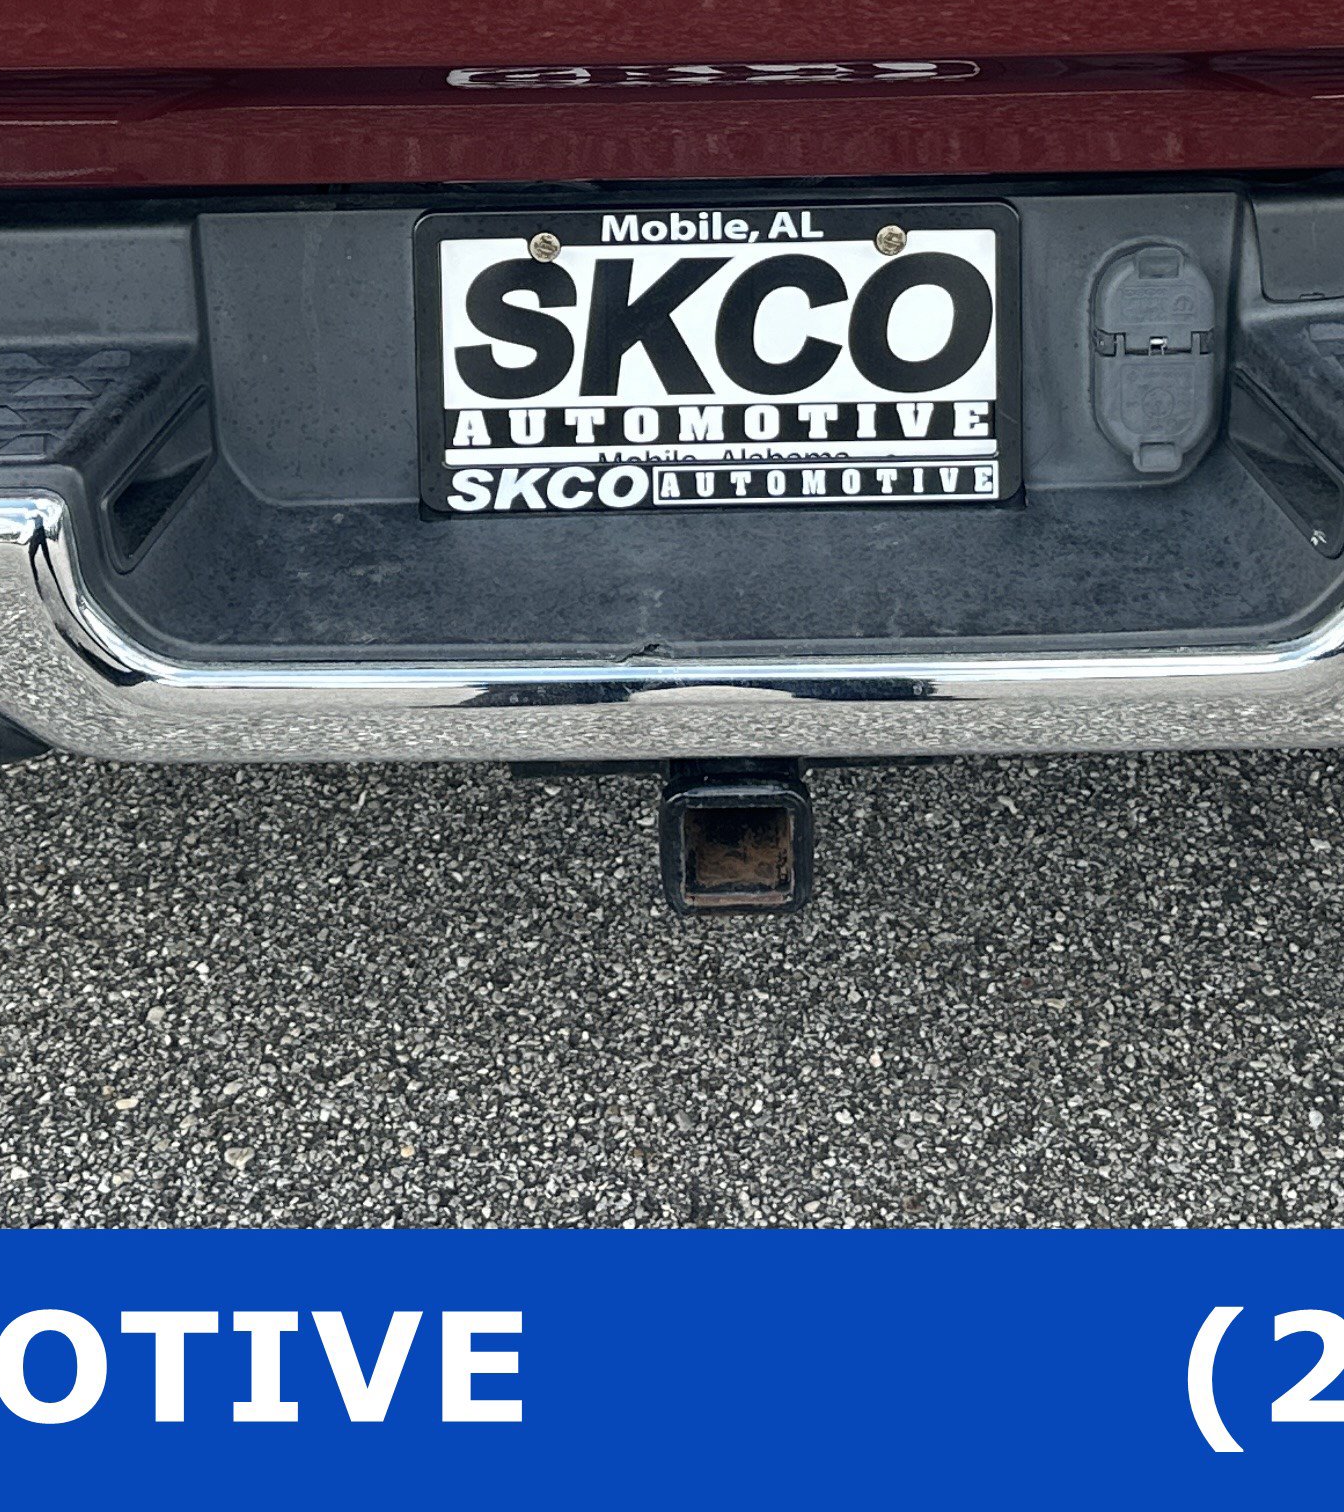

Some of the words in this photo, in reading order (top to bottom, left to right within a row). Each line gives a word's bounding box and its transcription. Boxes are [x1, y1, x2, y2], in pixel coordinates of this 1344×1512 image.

[601, 211, 760, 244] Mobile,
[768, 210, 824, 240] AL
[453, 251, 994, 401] SKCO
[452, 401, 990, 447] AUTOMOTIVE
[446, 464, 651, 512] SKCO
[660, 466, 994, 498] AUTOMOTIVE
